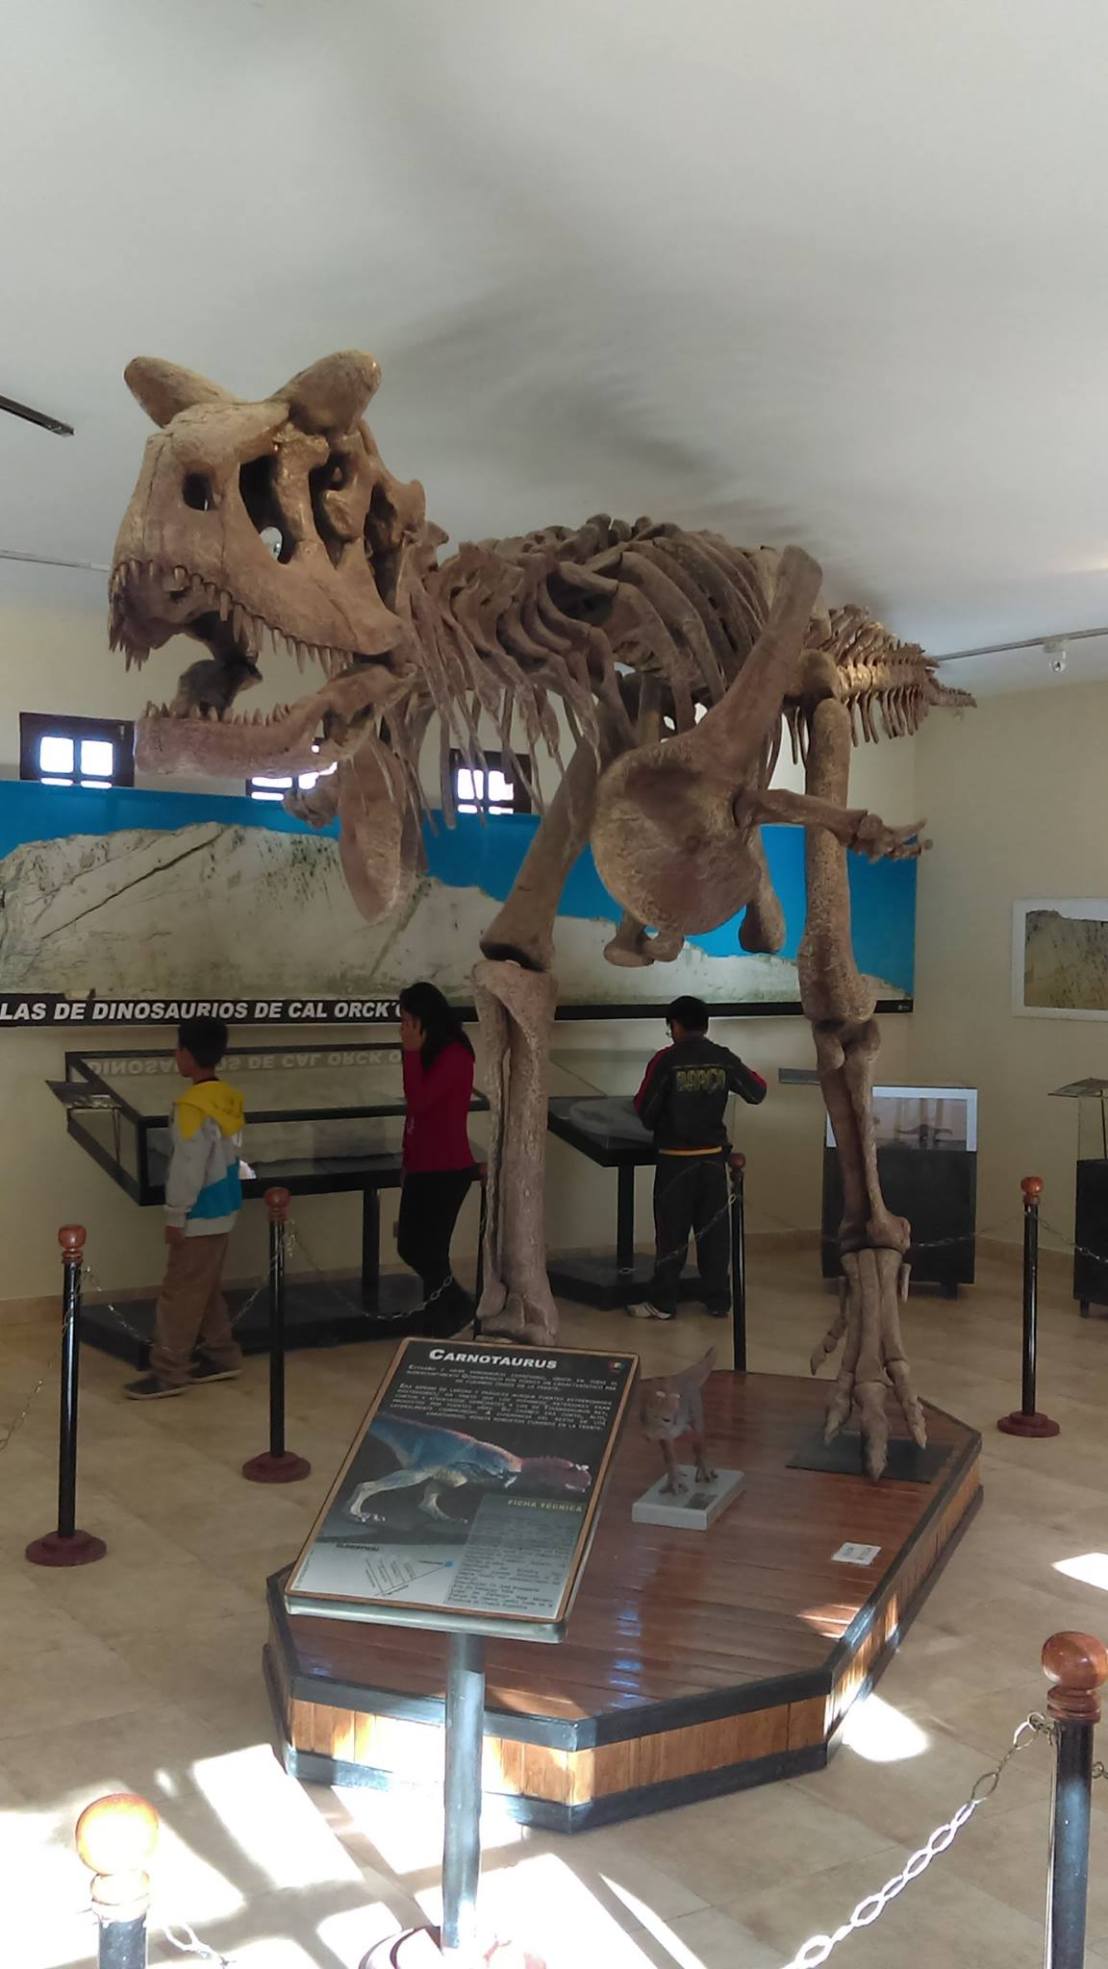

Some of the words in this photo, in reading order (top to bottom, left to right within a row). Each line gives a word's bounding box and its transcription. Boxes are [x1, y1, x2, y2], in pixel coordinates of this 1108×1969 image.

[54, 1003, 86, 1020] DE
[92, 1002, 248, 1020] DINOSAURIOS
[254, 1002, 282, 1018] DE
[288, 1002, 328, 1018] CAL
